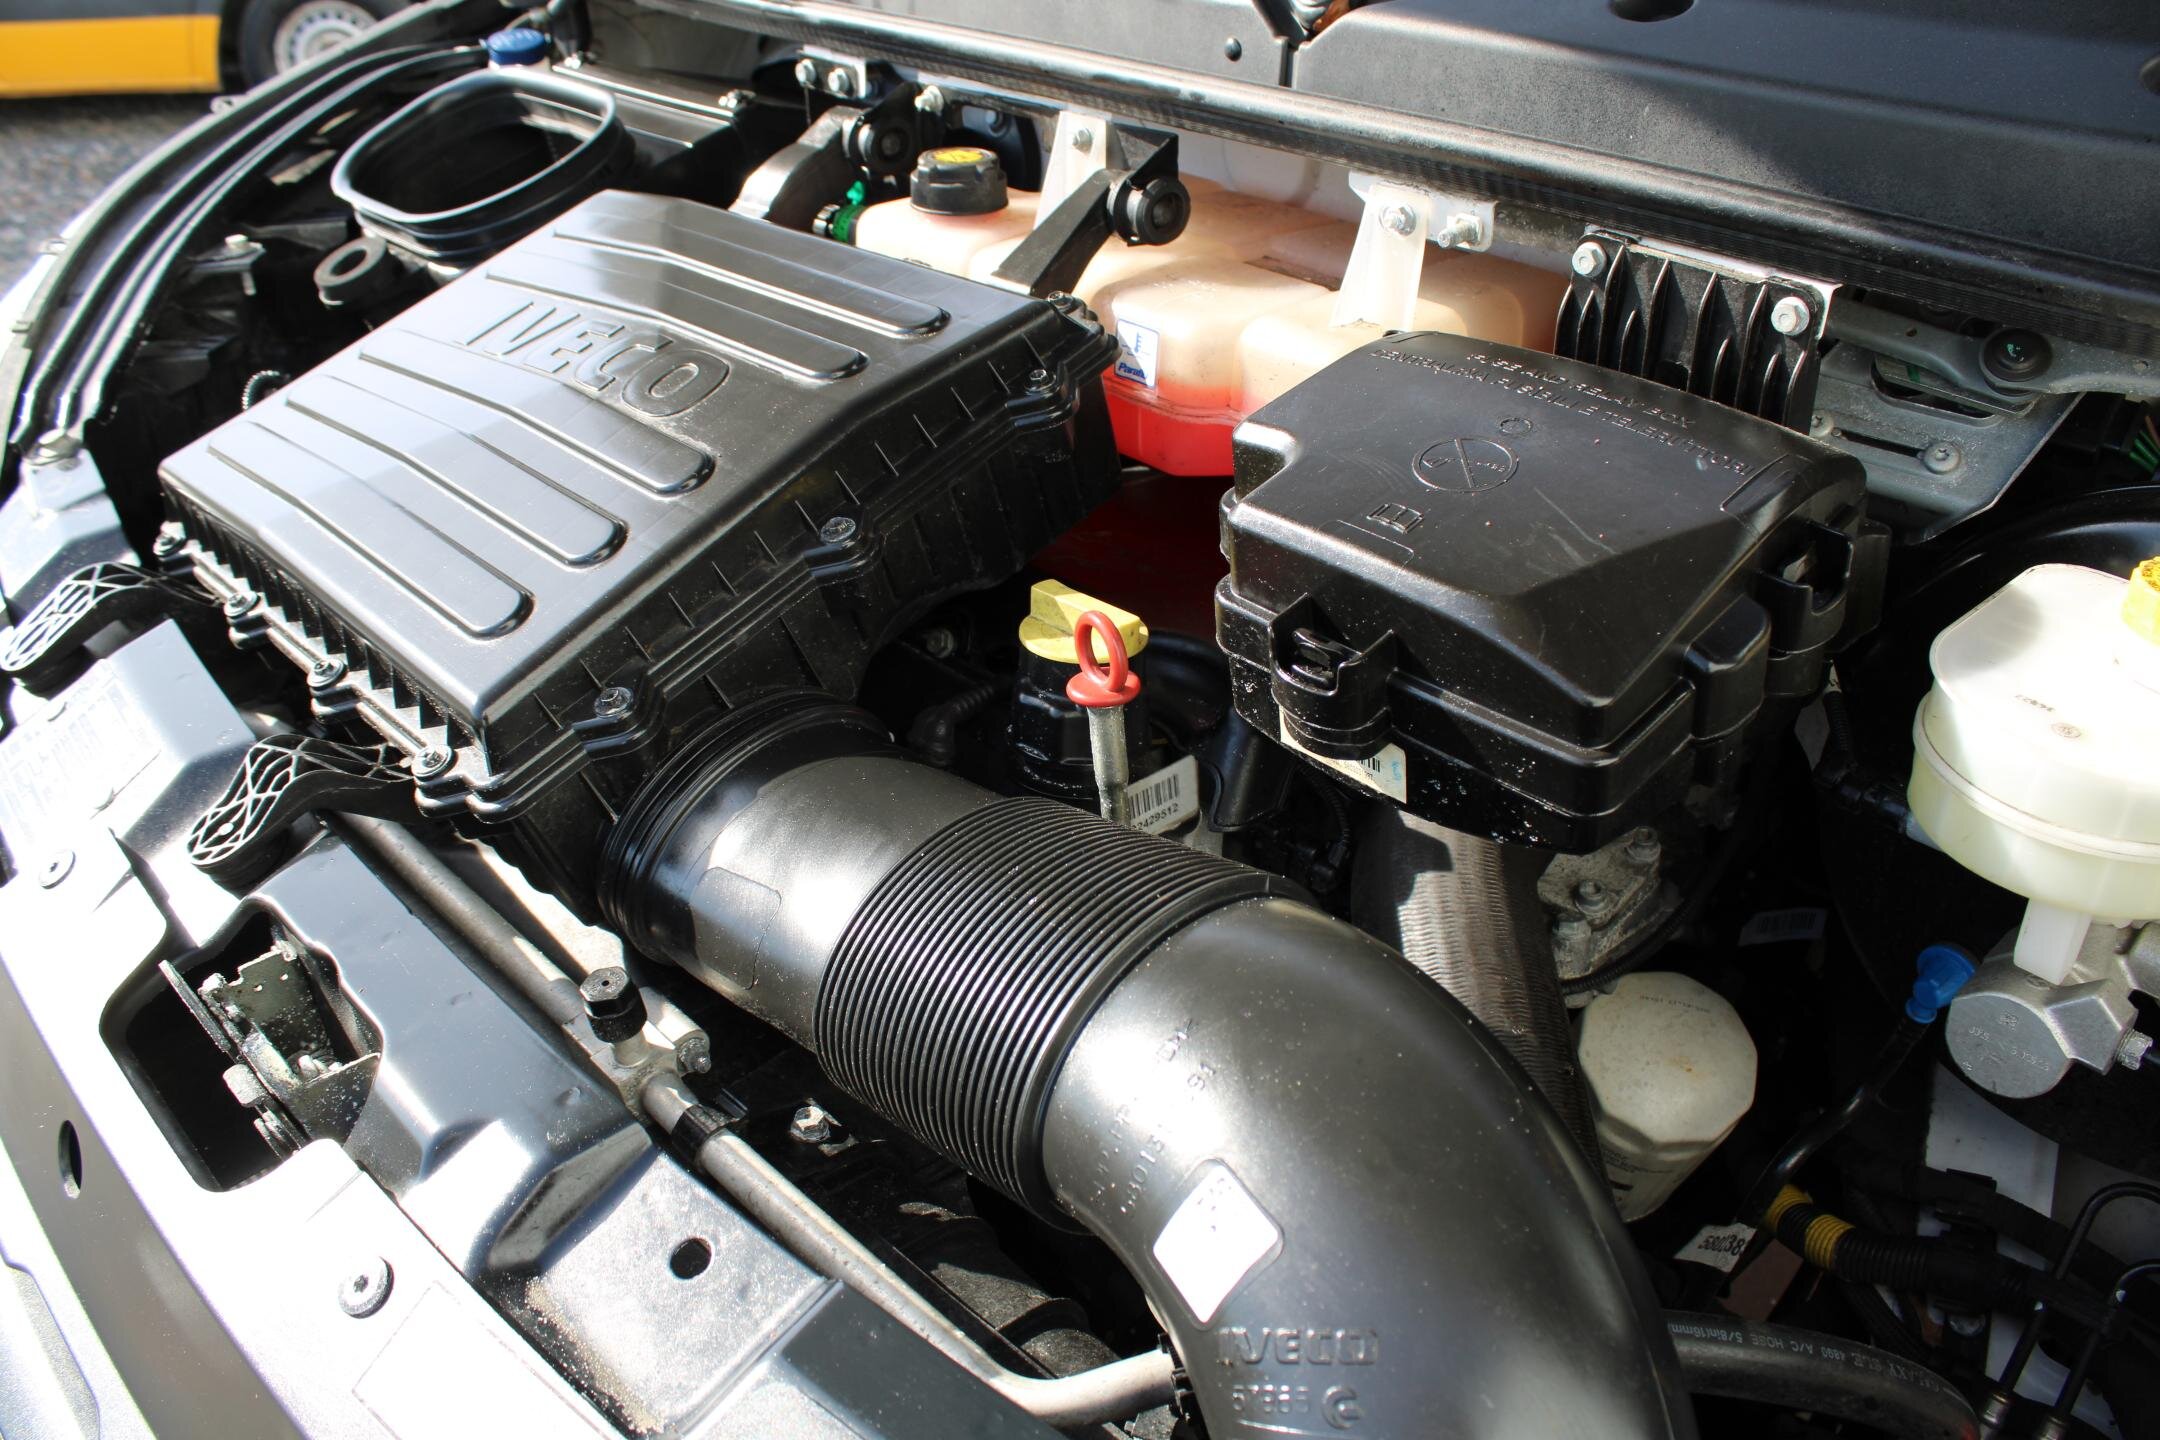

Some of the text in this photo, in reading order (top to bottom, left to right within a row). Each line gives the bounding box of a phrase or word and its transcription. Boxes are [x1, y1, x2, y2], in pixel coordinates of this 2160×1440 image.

[453, 301, 732, 418] IVECO
[1217, 1326, 1379, 1365] IVECO
[1749, 1333, 1785, 1349] HOSE
[1790, 1340, 1814, 1355] A/C
